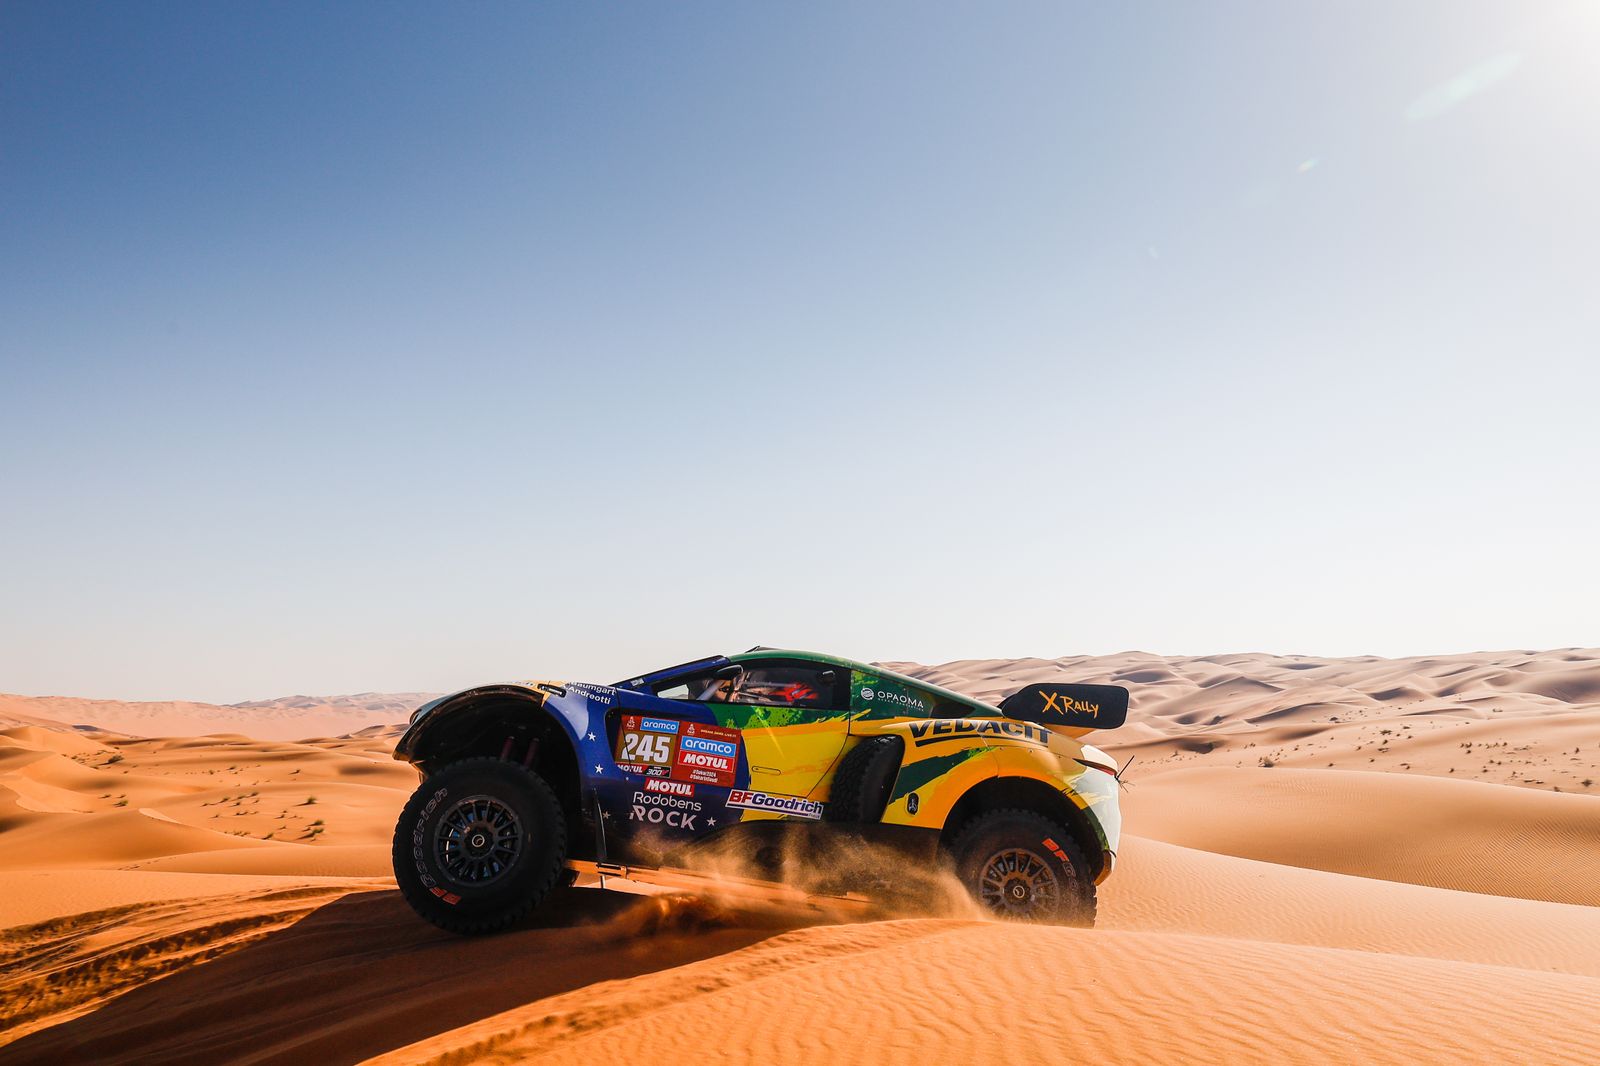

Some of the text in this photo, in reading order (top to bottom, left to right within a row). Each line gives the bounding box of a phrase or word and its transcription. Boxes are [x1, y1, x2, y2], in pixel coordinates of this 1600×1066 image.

[568, 686, 611, 704] Andreotti
[877, 691, 924, 708] OPAOMA
[1038, 690, 1064, 715] X
[643, 721, 676, 730] aramco
[909, 719, 1051, 743] VEDACIT
[621, 733, 671, 763] 245
[685, 739, 732, 754] aramco
[683, 753, 728, 769] MOTUL
[646, 779, 692, 795] MOTUL
[633, 791, 702, 812] Rodobens
[729, 790, 823, 814] BFGoodrich
[629, 804, 697, 831] ROCK
